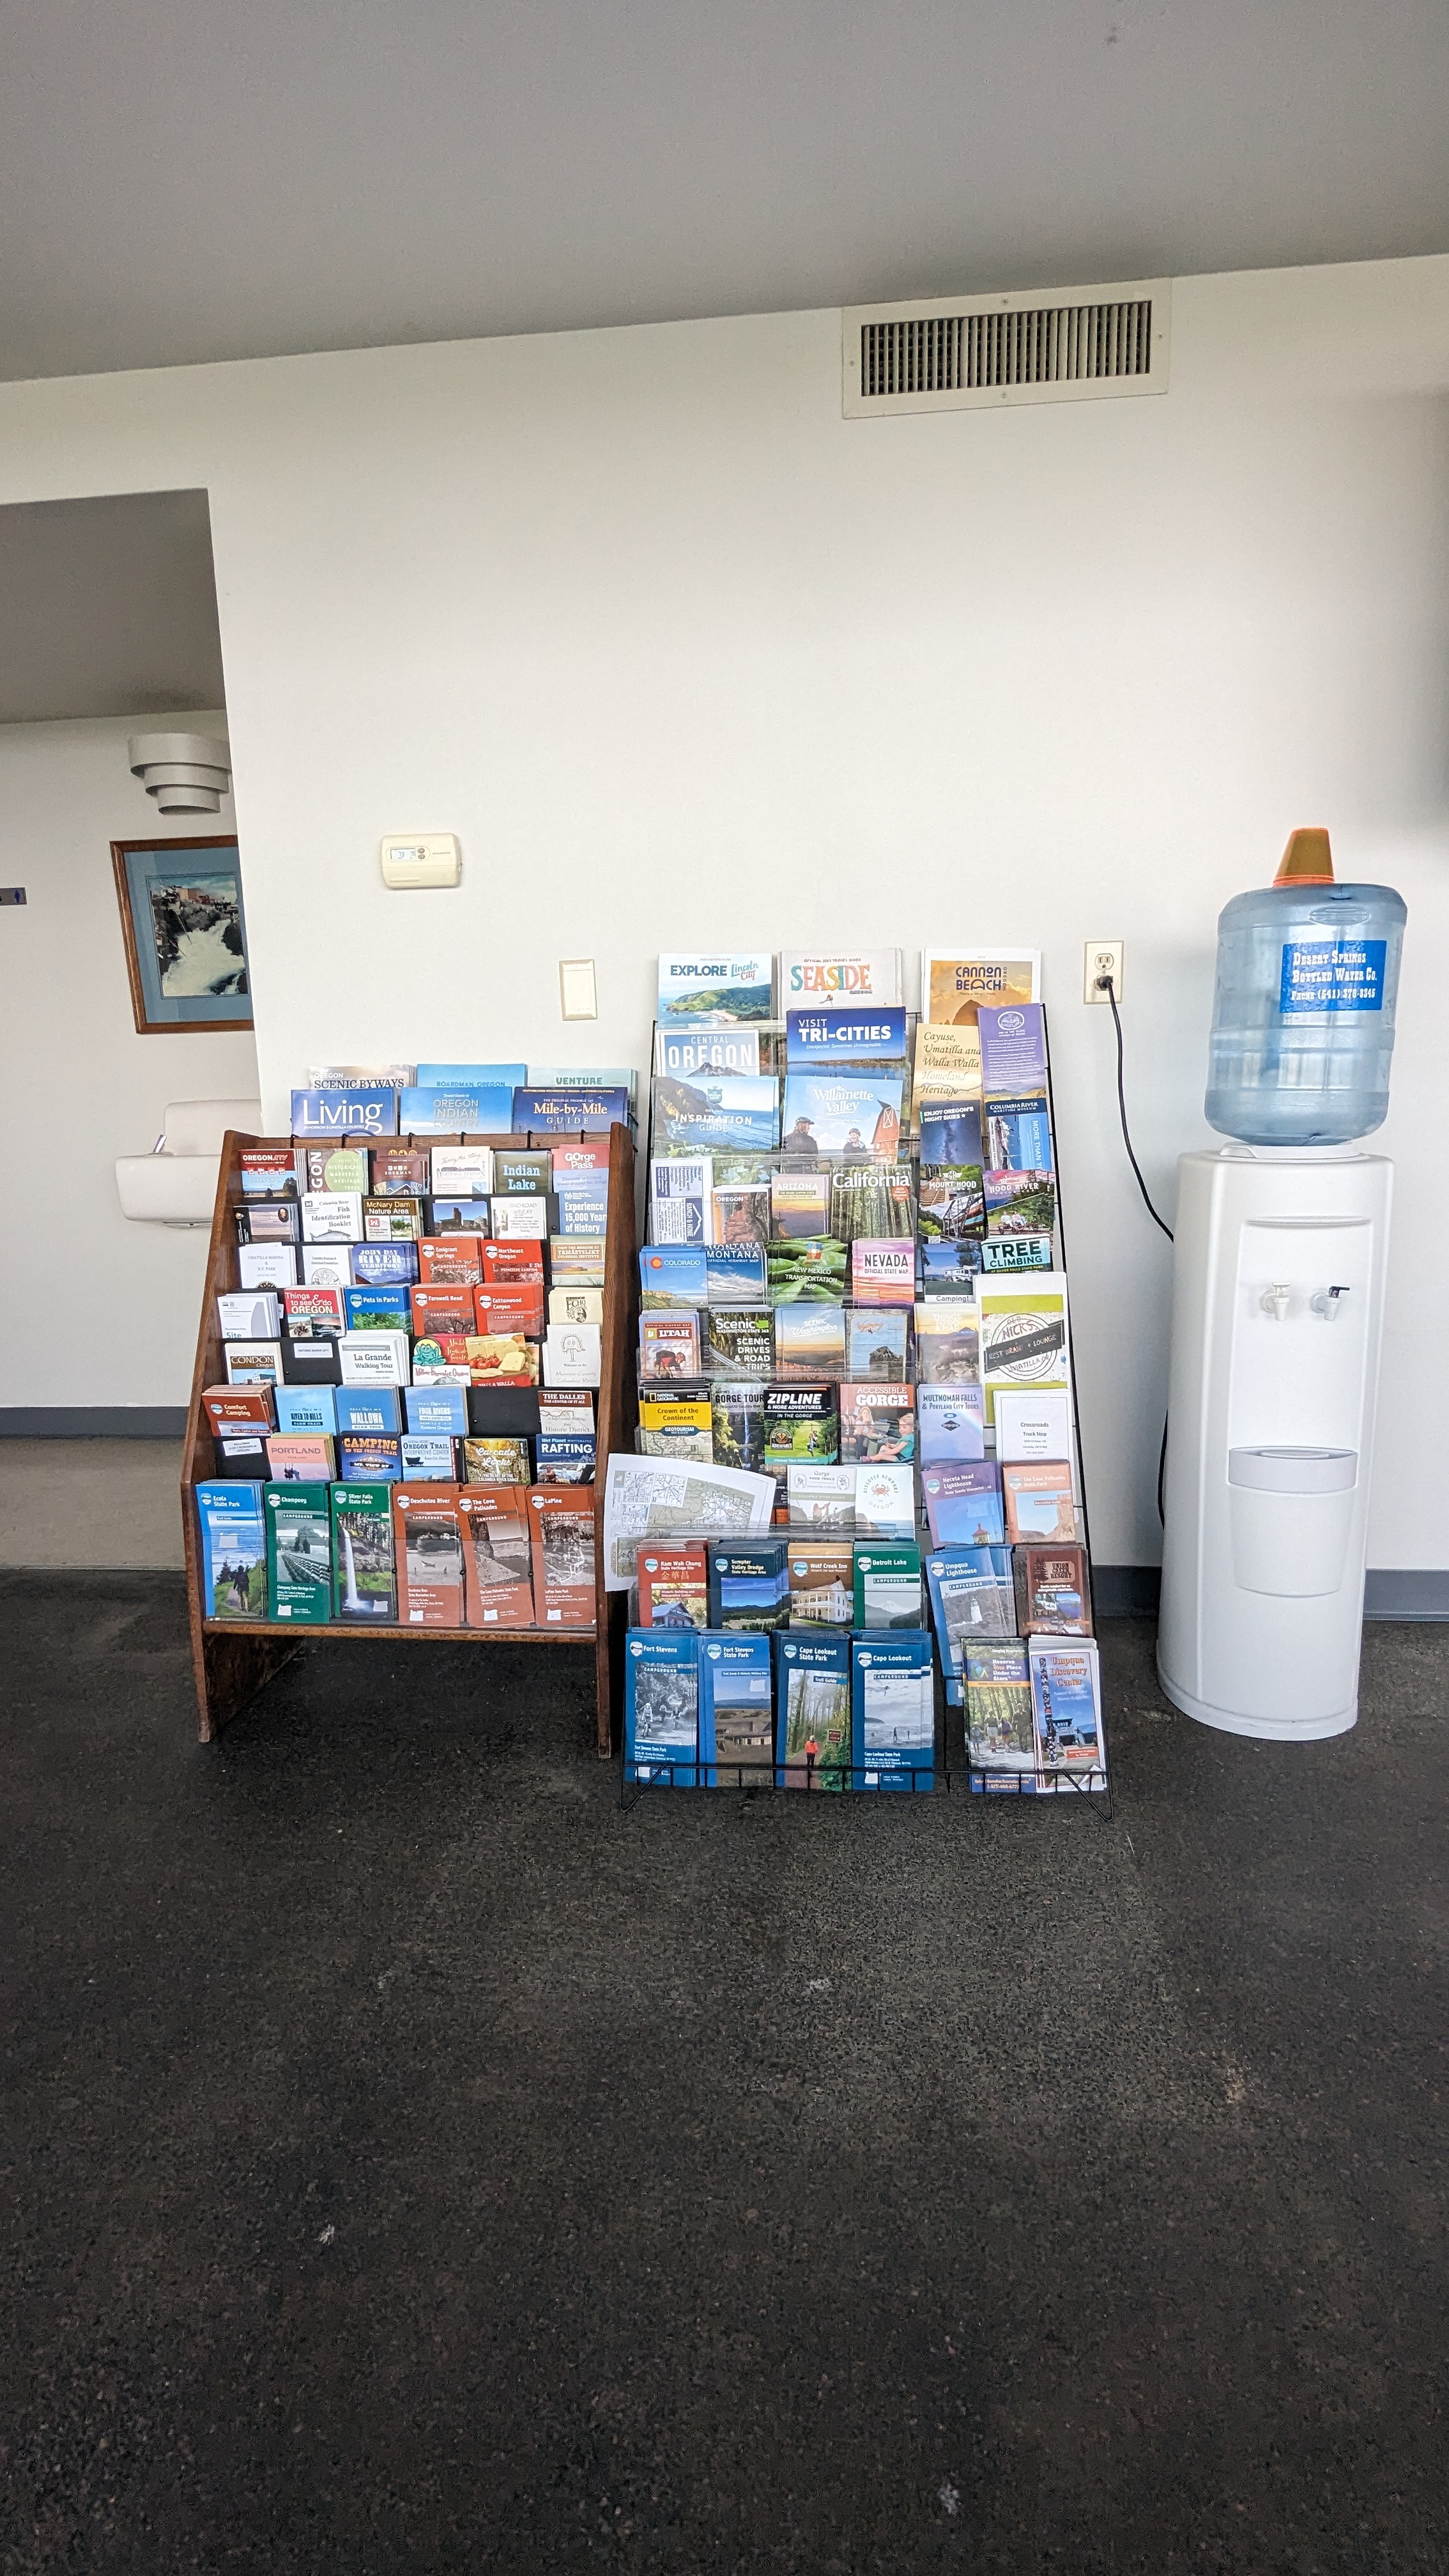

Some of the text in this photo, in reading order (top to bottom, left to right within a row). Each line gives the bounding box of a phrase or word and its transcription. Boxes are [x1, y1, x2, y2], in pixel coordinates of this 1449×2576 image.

[670, 961, 758, 977] EXPLORE Lincoln
[956, 967, 1001, 977] CANNON
[741, 970, 755, 981] City
[790, 964, 872, 992] SEASIDE
[956, 979, 1001, 990] BEACH
[1318, 989, 1340, 999] (541)
[799, 1026, 891, 1042] TRI-CITIES
[924, 1032, 956, 1042] Cayuse,
[924, 1045, 962, 1054] Umatilla
[668, 1045, 752, 1068] OREGON
[924, 1057, 979, 1068] Walla Walla
[314, 1078, 404, 1089] SCENIC BYWAYS
[921, 1085, 958, 1095] Heritage
[434, 1109, 478, 1117] INDIAN
[533, 1102, 607, 1115] Mile-by-Mile
[825, 1101, 859, 1114] Valley
[303, 1100, 383, 1135] Living
[503, 1165, 540, 1176] Indian
[508, 1179, 535, 1190] Lake
[832, 1170, 910, 1188] California
[990, 1185, 1011, 1193] HOOD
[366, 1201, 392, 1209] McNary
[564, 1202, 604, 1212] Experience
[565, 1223, 600, 1234] of History
[988, 1241, 1041, 1258] TREE
[358, 1255, 402, 1264] RIVER
[864, 1254, 908, 1266] NEVADA
[990, 1256, 1043, 1268] CLIMBING
[716, 1318, 755, 1330] Scenic
[768, 1394, 822, 1404] ZIPLINE
[857, 1394, 908, 1406] GORGE
[350, 1413, 383, 1424] WALLOWA
[344, 1438, 398, 1450] CAMPING
[542, 1444, 592, 1453] RAFTING
[947, 1568, 976, 1576] Lighthouse
